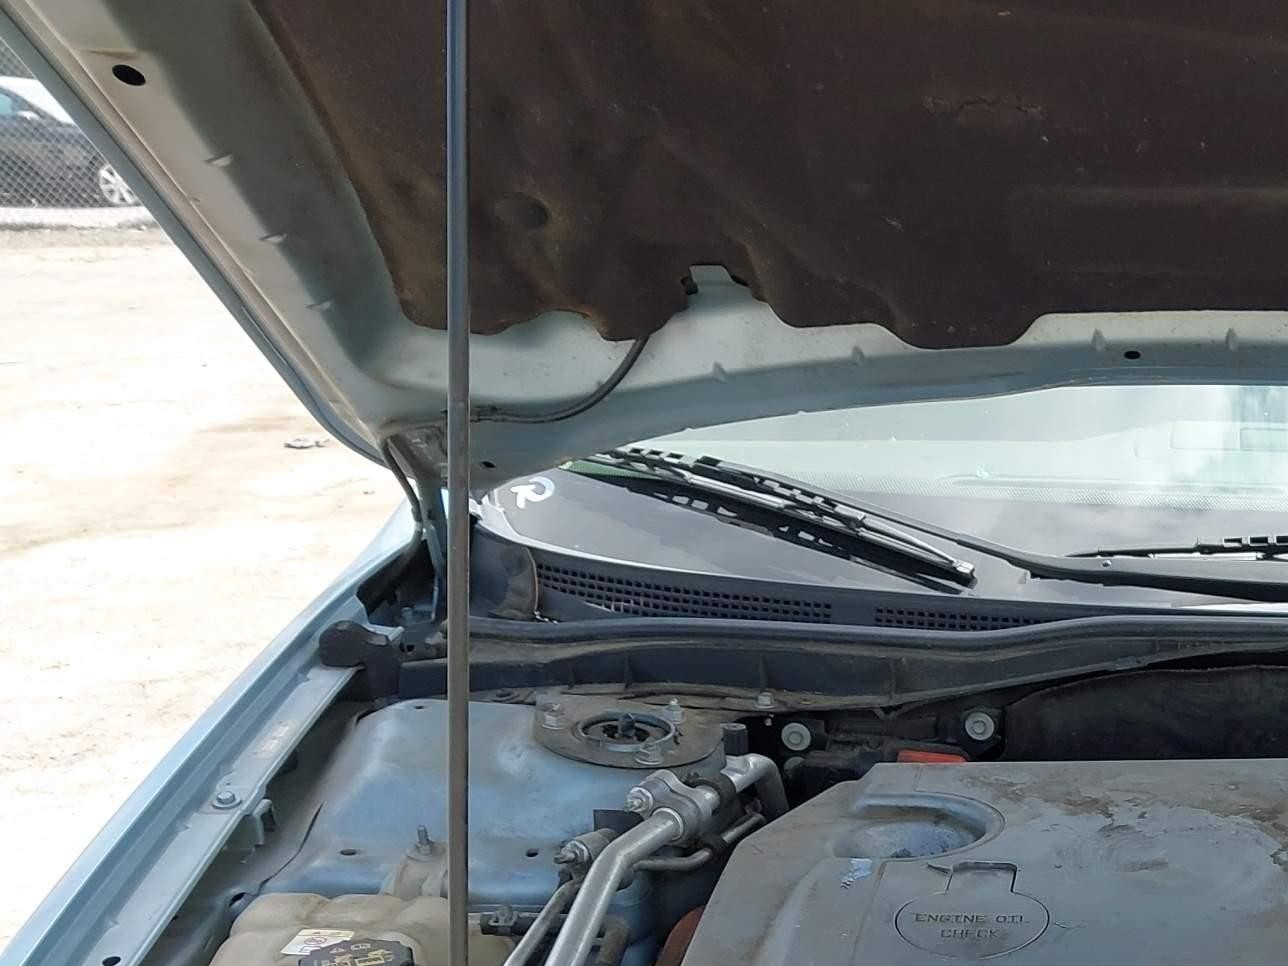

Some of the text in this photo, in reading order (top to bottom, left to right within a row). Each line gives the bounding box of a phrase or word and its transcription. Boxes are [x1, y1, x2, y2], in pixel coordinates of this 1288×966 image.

[913, 912, 1029, 925] ENGINE OIL
[939, 928, 1000, 939] CHECK
